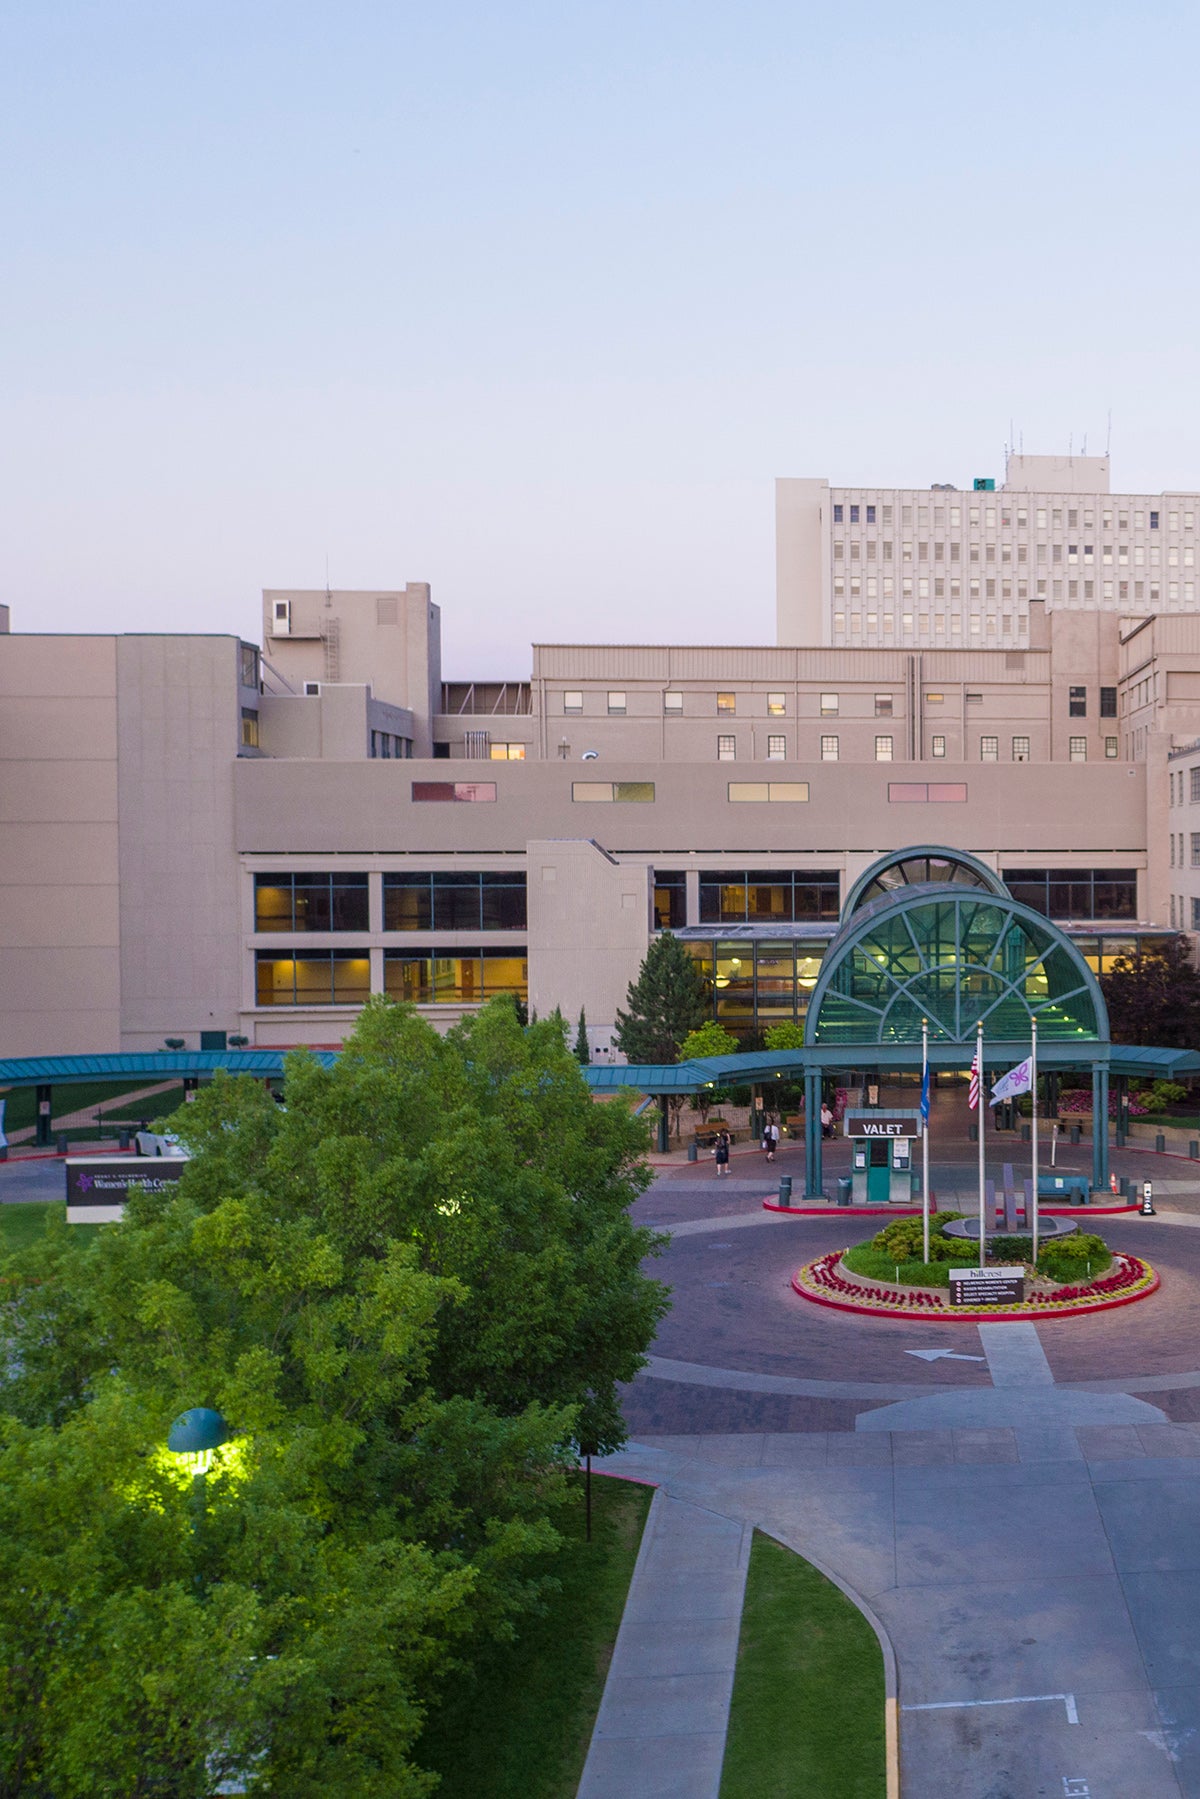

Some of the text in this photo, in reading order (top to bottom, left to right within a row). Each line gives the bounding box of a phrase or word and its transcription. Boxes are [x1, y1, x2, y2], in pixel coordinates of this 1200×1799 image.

[863, 1124, 903, 1134] VALET
[93, 1179, 128, 1189] Women's
[127, 1178, 153, 1189] Hlth
